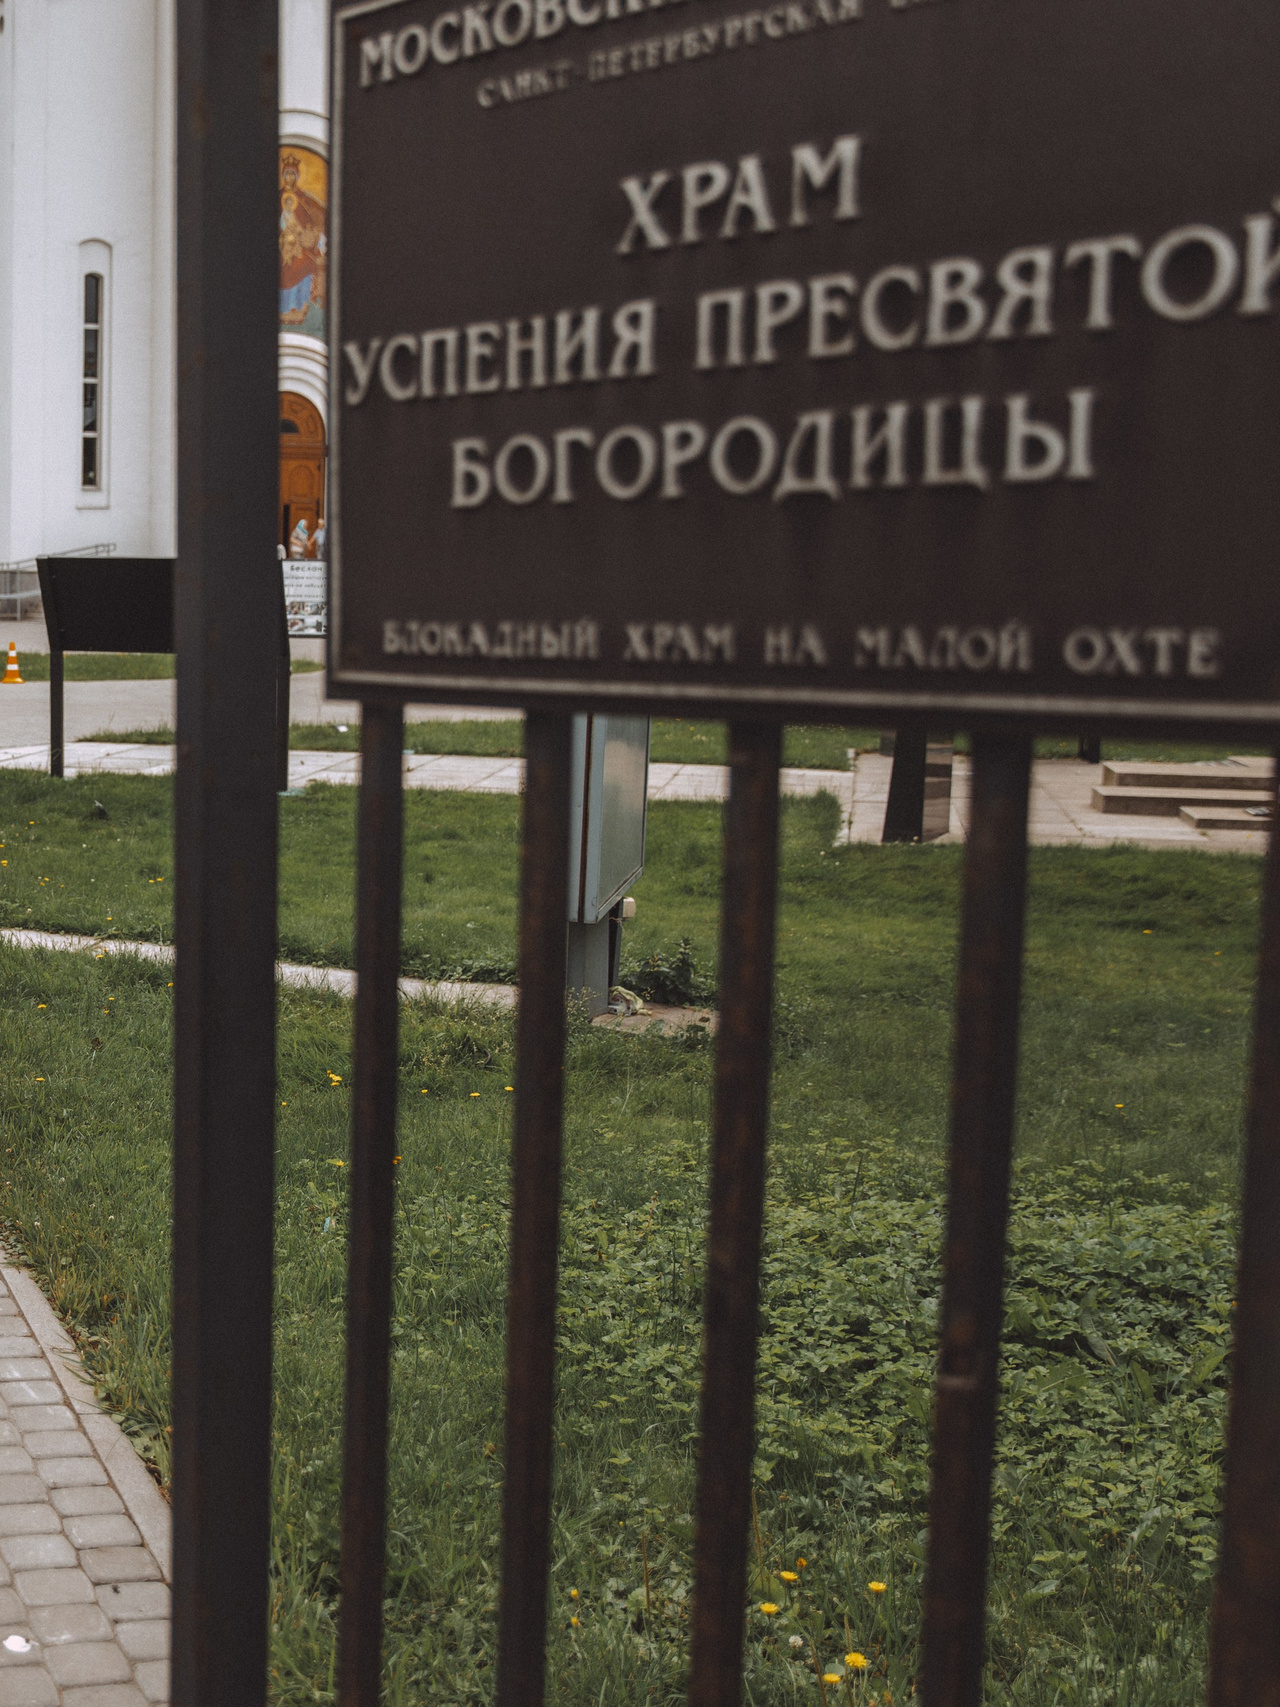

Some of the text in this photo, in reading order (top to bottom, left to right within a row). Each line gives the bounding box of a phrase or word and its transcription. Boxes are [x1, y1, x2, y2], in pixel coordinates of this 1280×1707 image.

[616, 134, 861, 254] ХРАМ
[344, 299, 655, 404] УСПЕНИЯ
[450, 386, 1094, 508] БОГОРОДИЦЫ
[382, 615, 1218, 677] БЛОКАДНЫЙ ХРАМ НА МАЛОЙ ОХТЕ
